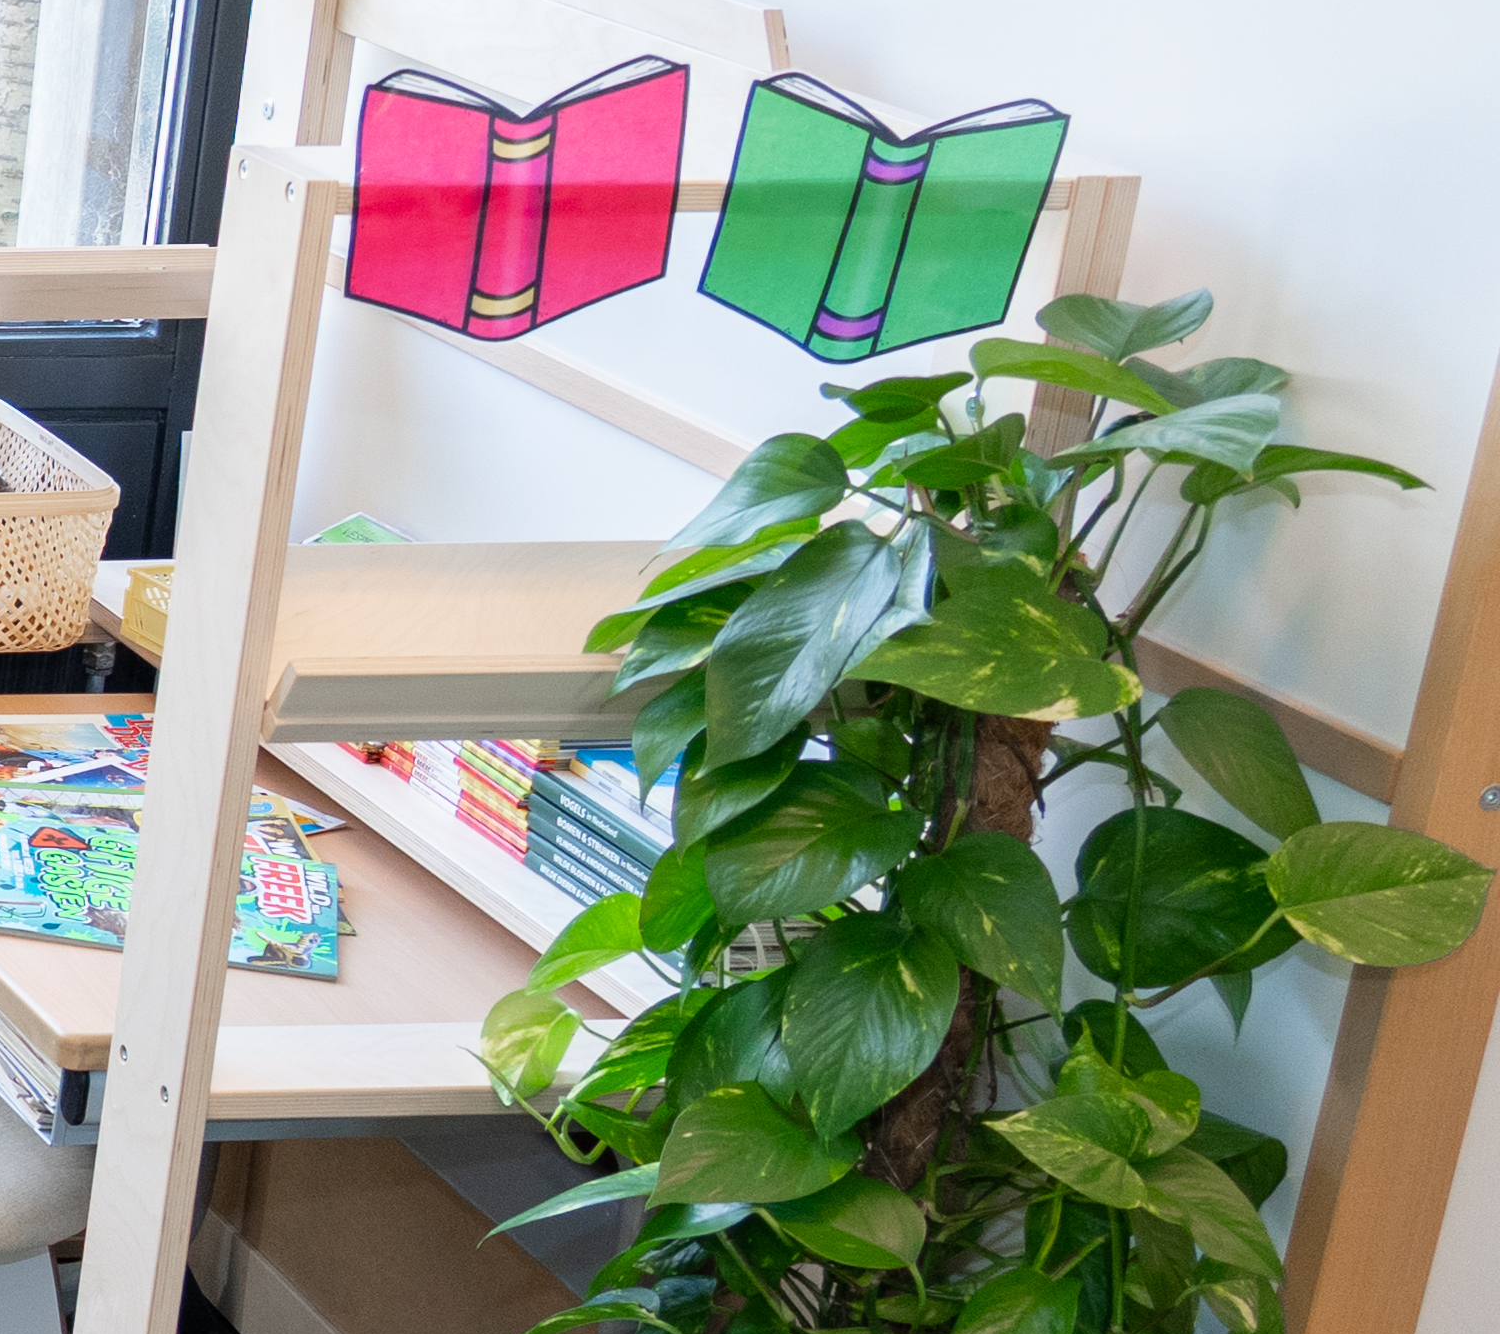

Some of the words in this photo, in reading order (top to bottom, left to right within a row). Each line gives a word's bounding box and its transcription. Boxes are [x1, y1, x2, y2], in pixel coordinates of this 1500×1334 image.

[560, 794, 586, 818] VOGELS
[255, 859, 307, 920] FREEK
[306, 871, 332, 907] WILD
